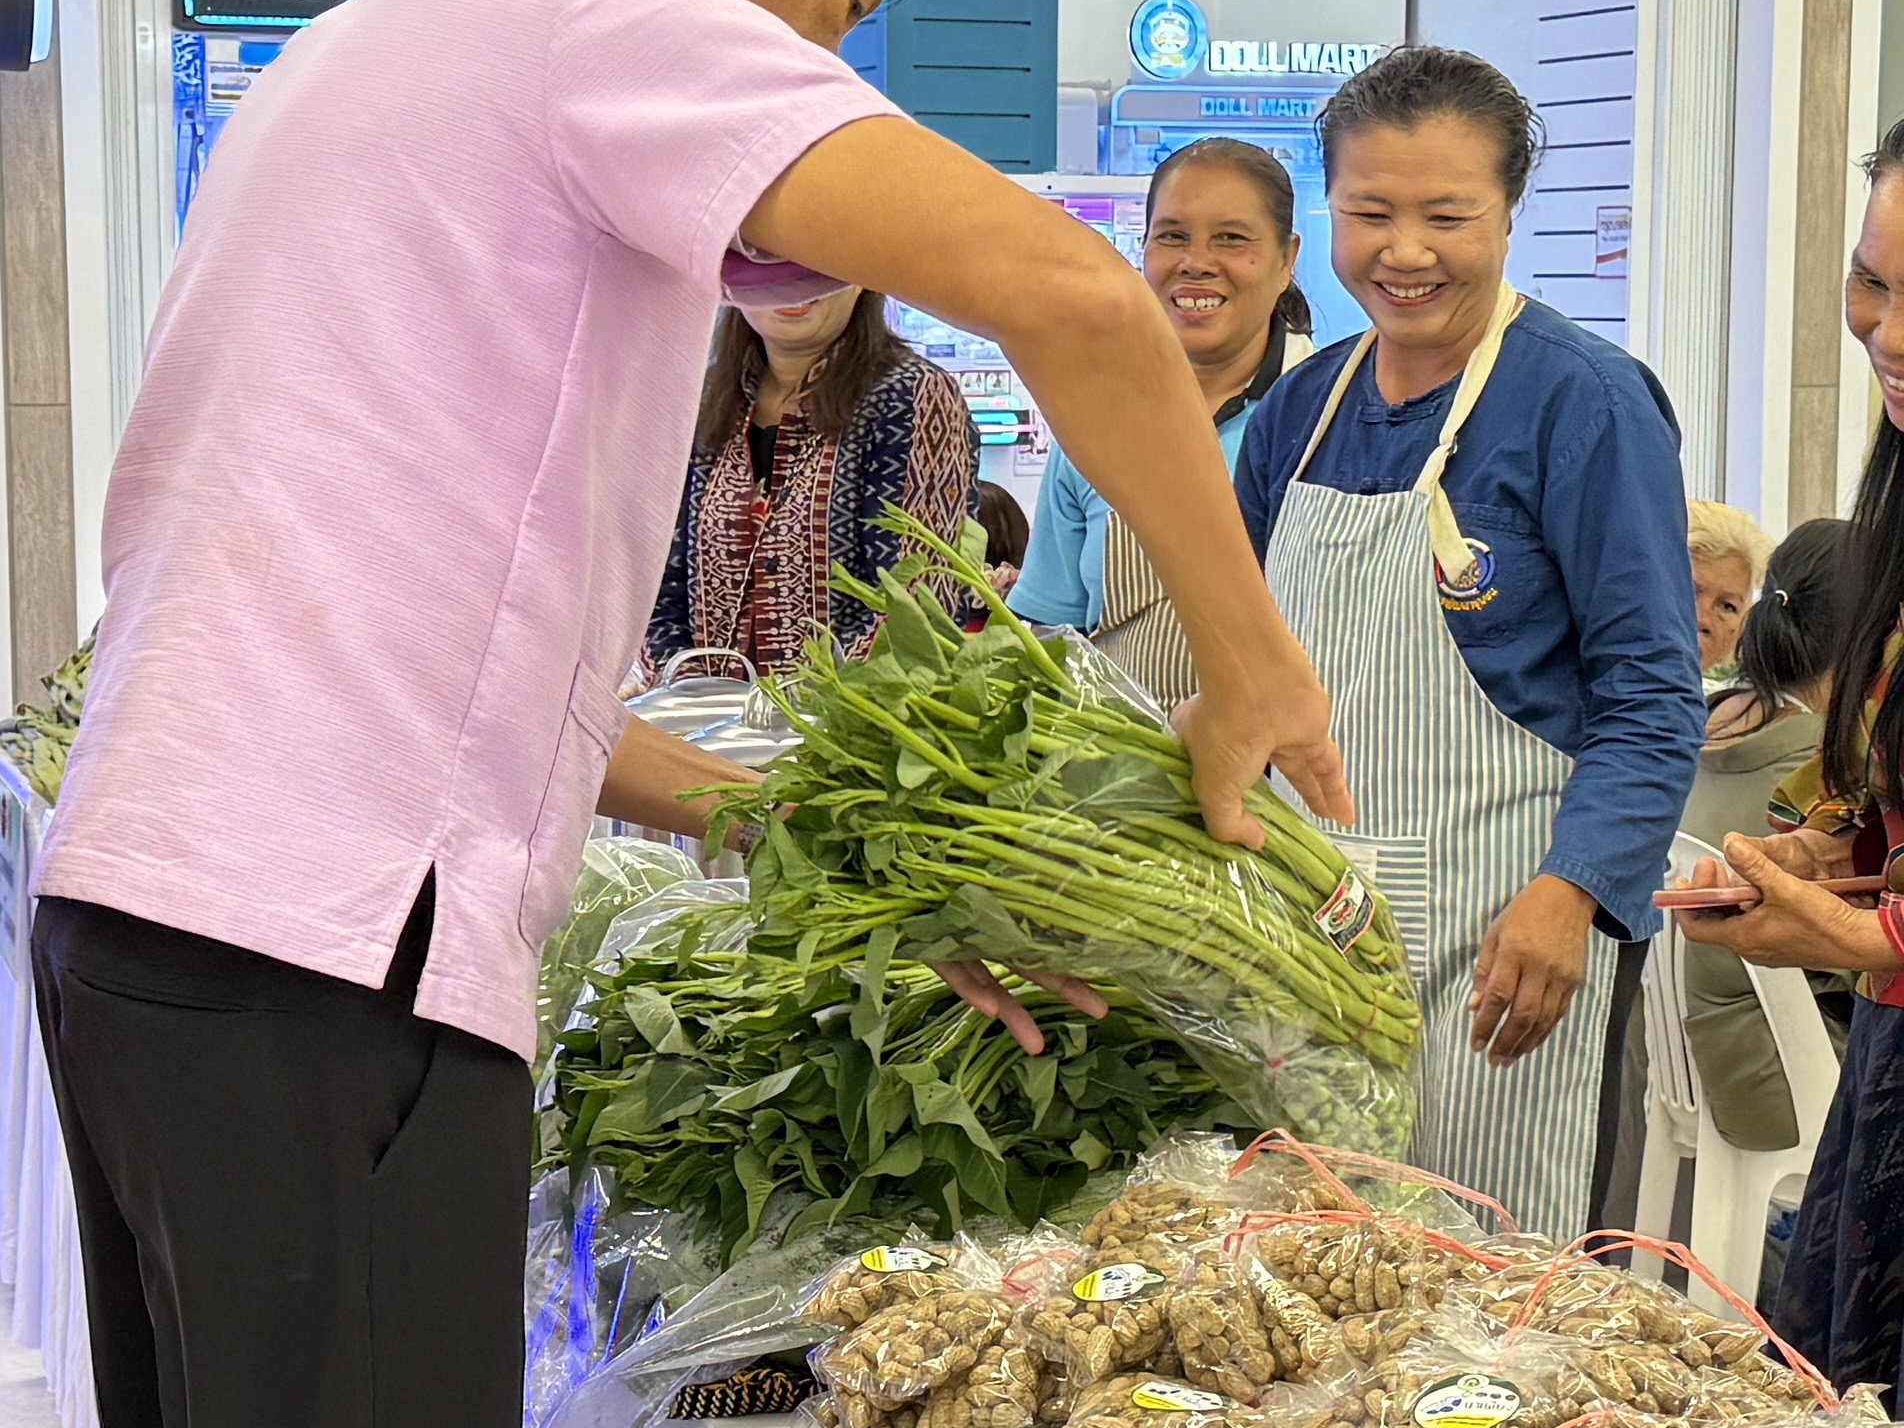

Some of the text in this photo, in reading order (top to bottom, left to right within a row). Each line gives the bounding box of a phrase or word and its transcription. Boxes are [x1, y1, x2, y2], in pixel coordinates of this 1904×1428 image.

[1208, 39, 1286, 75] DOLL
[1199, 96, 1317, 119] DOLL MART
